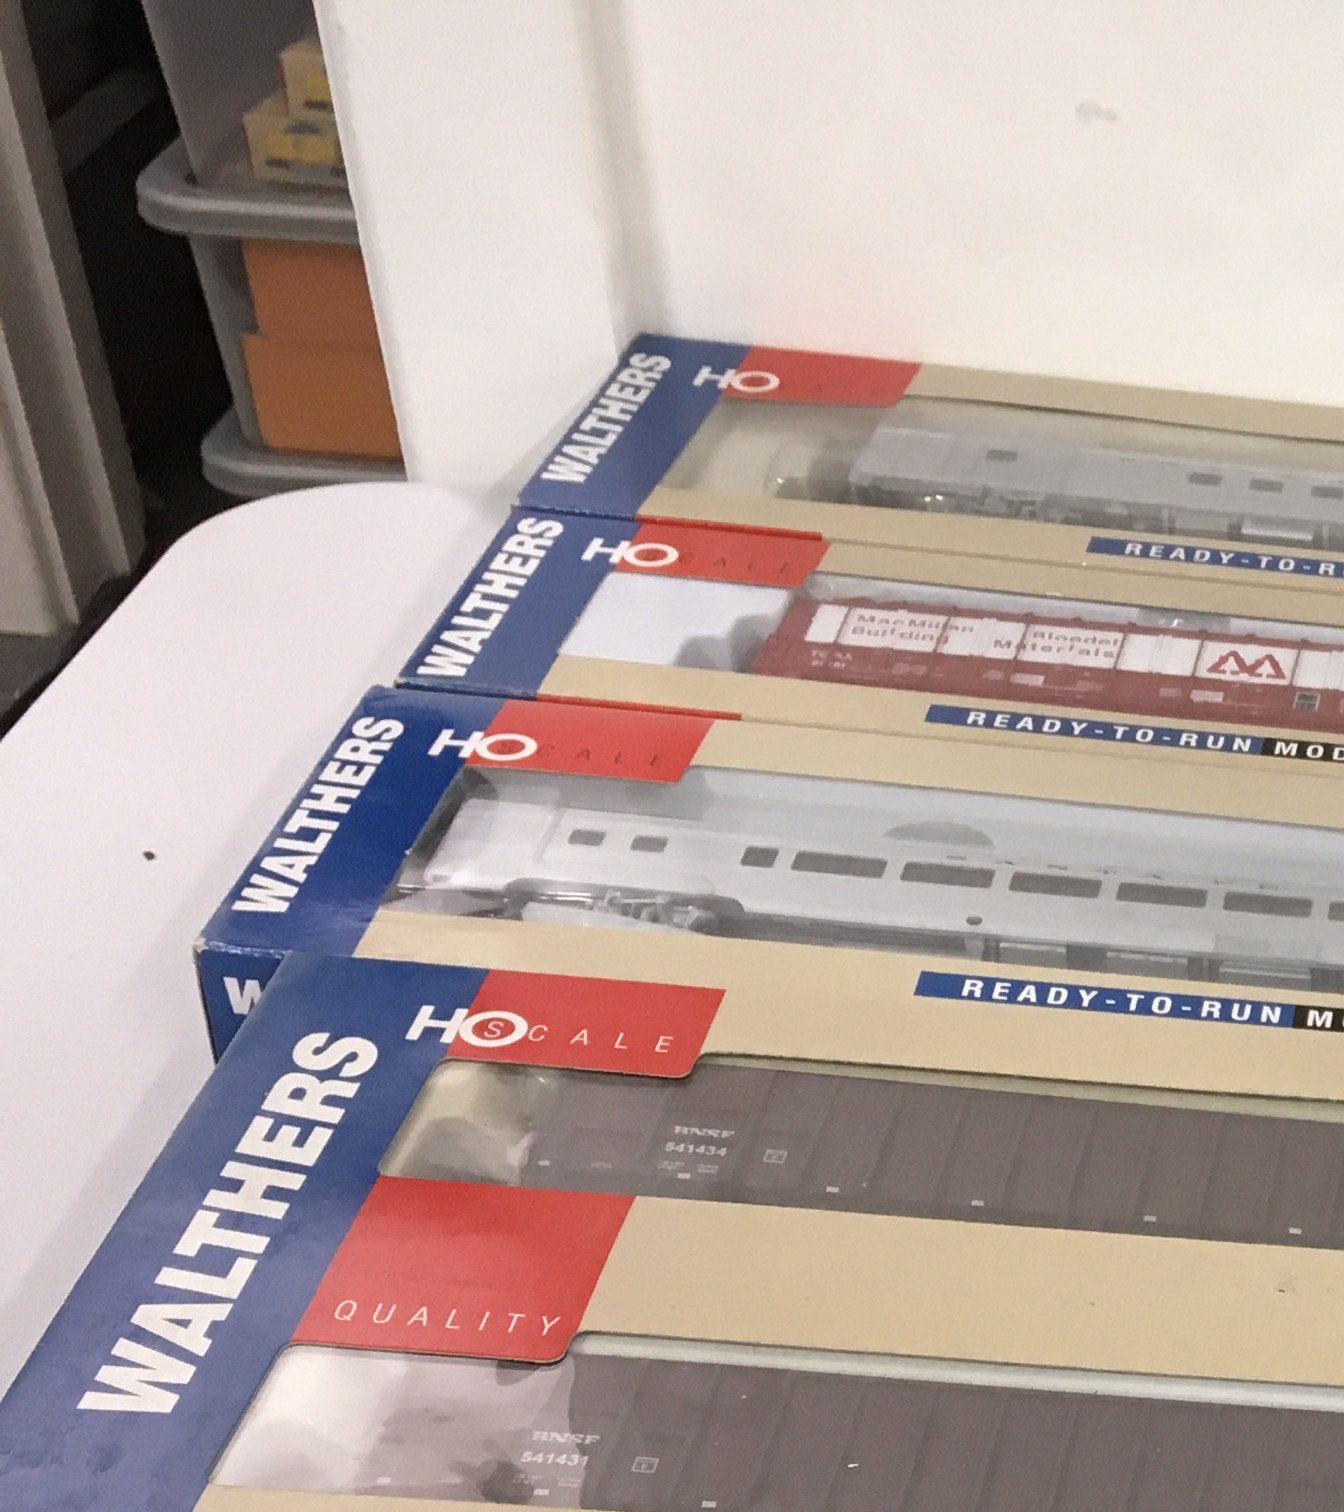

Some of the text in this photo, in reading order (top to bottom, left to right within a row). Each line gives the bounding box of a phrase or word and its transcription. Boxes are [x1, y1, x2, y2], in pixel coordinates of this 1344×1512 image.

[693, 364, 780, 394] HO
[541, 353, 671, 486] WALTHERS
[580, 537, 679, 569] HO
[416, 516, 565, 677] WALTHERS
[427, 730, 539, 763] HO
[965, 710, 1253, 753] READY-TO-RUN
[231, 714, 406, 914] WALTHERS
[960, 978, 1284, 1026] READY-TO-RUN
[404, 1004, 528, 1047] HO
[482, 1017, 675, 1054] SCALE
[662, 1141, 729, 1158] 541434
[672, 1124, 736, 1140] BNSF
[76, 1031, 381, 1415] WALTHERS
[331, 1298, 564, 1339] QUALITY
[529, 1430, 601, 1446] BNSF
[518, 1450, 591, 1468] 541431
